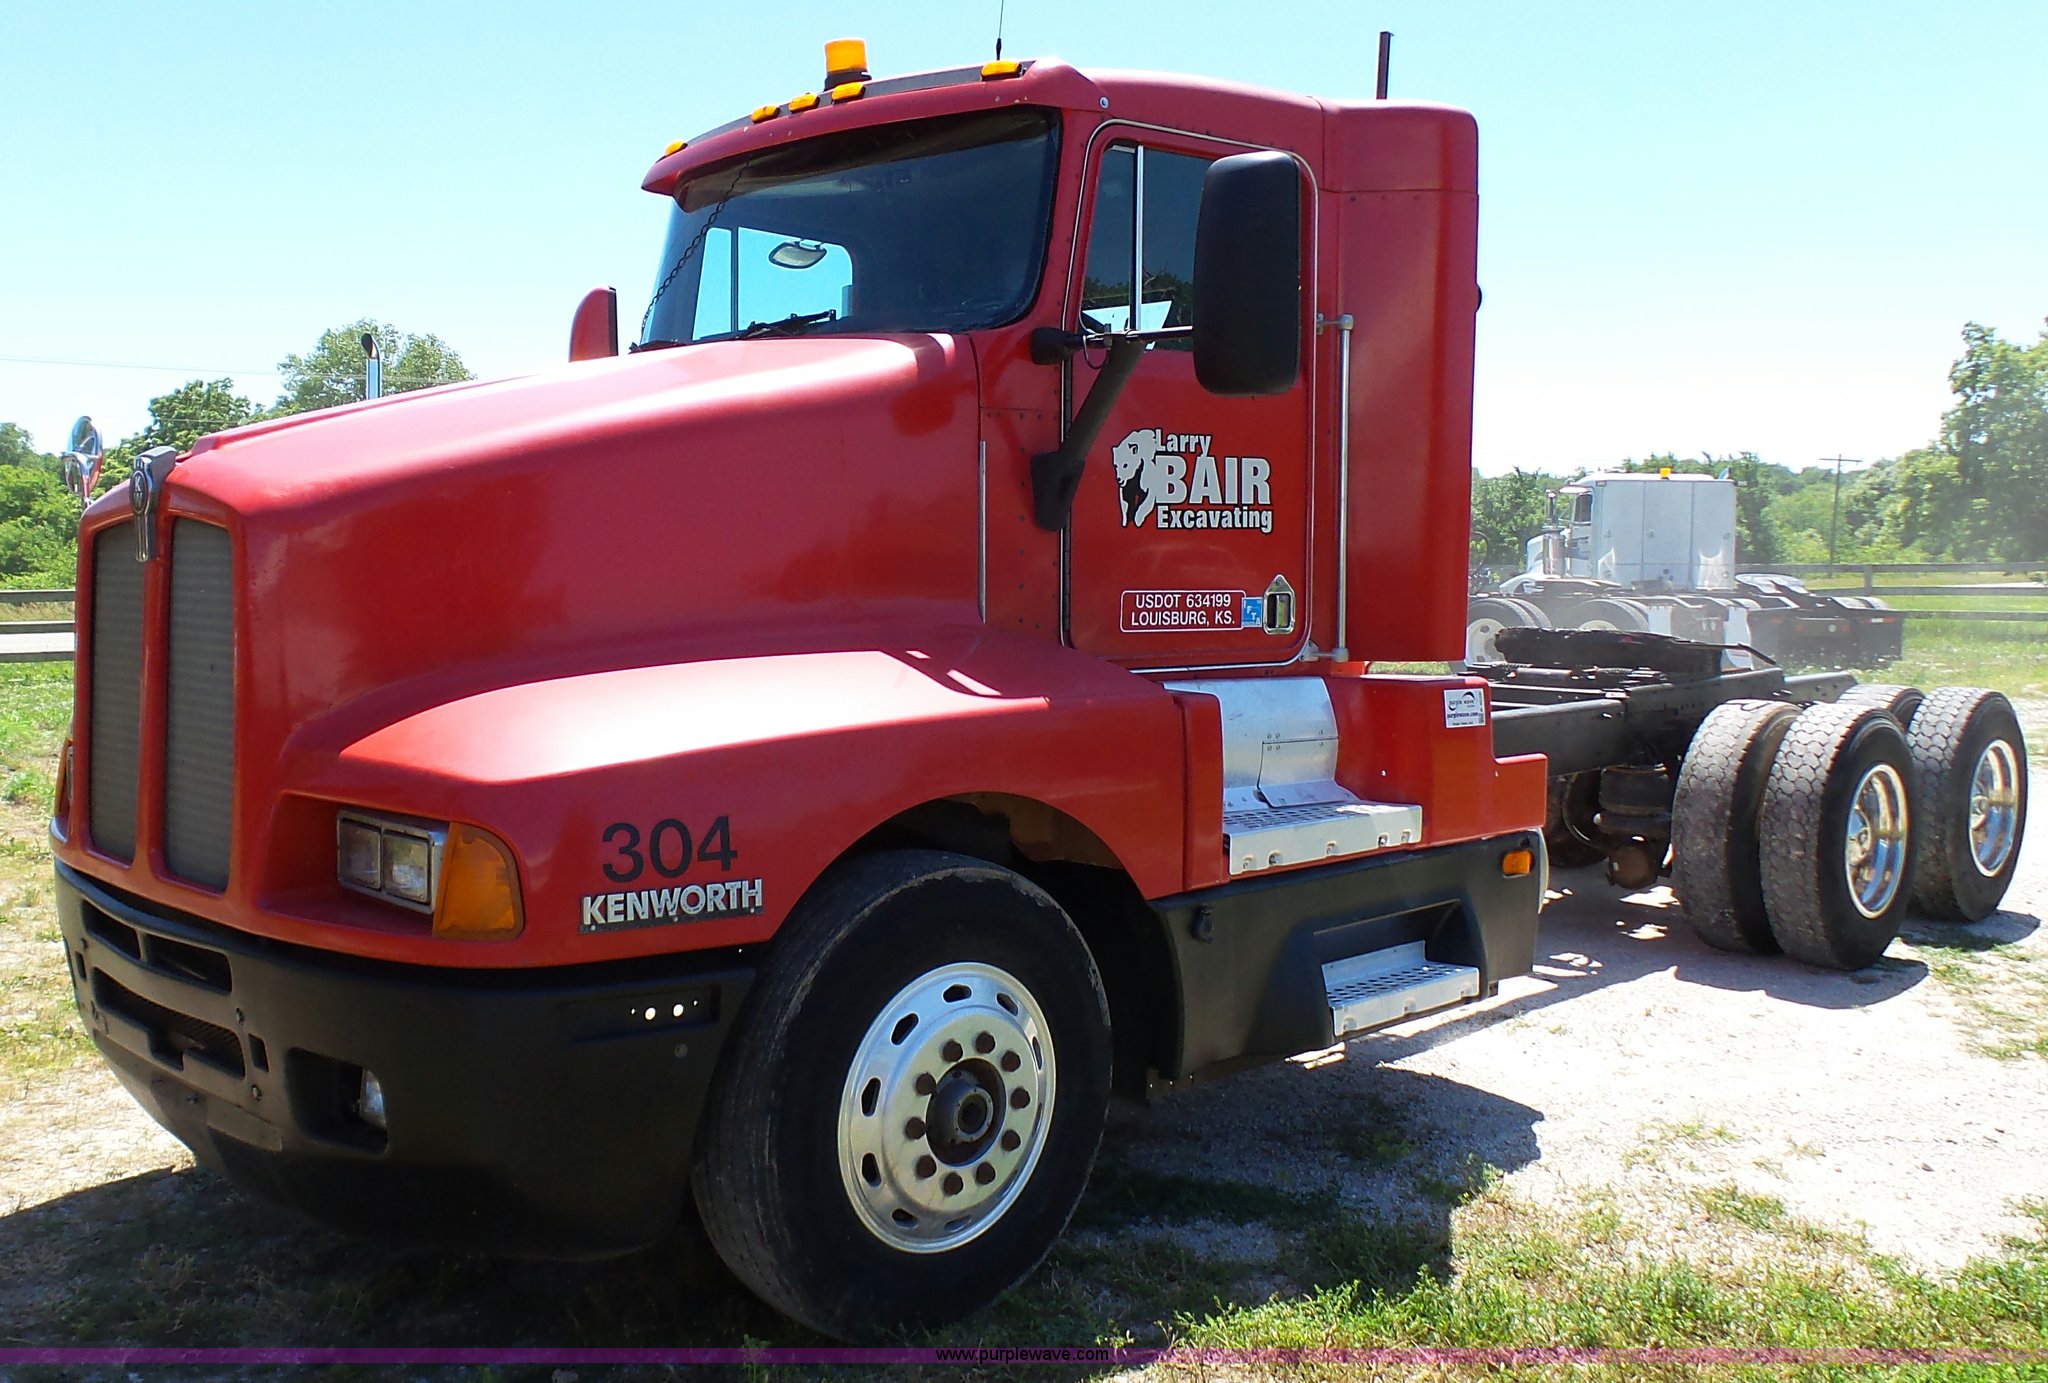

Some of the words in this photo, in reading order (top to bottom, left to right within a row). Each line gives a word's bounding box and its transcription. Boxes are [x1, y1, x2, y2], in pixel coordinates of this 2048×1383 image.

[1155, 429, 1212, 457] Larry
[1155, 455, 1271, 505] BAIR
[1157, 505, 1273, 533] Excavating
[1135, 594, 1181, 609] USDOT
[1186, 593, 1231, 608] 634199
[1131, 610, 1210, 627] LOUISBURG,
[1214, 611, 1236, 625] KS.
[602, 815, 738, 883] 304
[582, 878, 763, 926] KENWORTH
